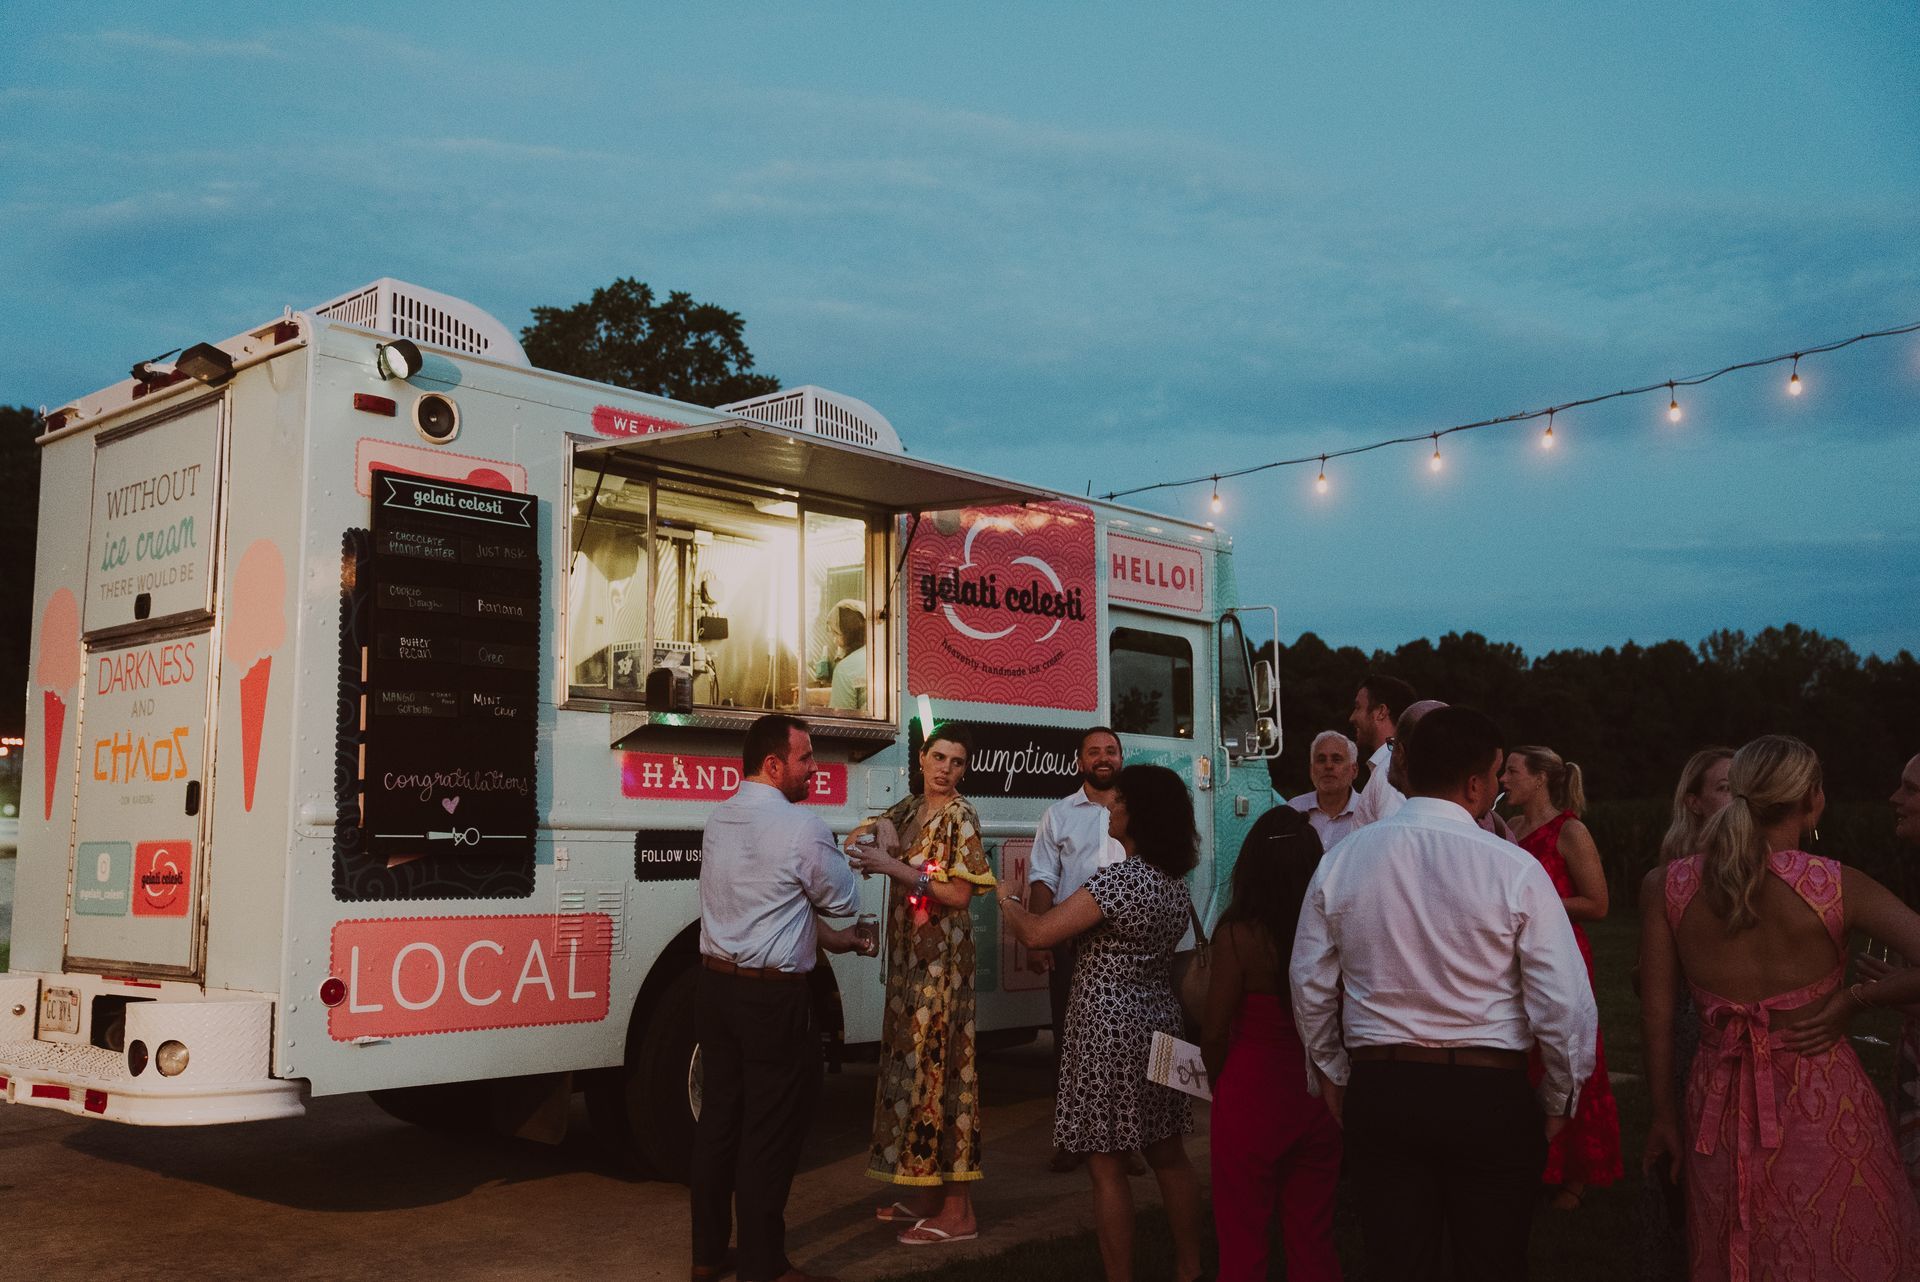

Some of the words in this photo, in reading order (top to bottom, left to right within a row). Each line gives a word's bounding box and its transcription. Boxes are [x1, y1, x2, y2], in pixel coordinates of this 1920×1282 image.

[613, 416, 639, 434] WE
[107, 464, 201, 520] WITHOUT
[414, 489, 455, 506] gelati
[458, 498, 503, 515] celesti
[101, 531, 130, 572] ice
[136, 515, 197, 561] cream
[476, 544, 500, 559] JUST
[100, 577, 133, 601] THERE
[137, 567, 177, 592] WOULD
[180, 563, 195, 582] BE
[1112, 553, 1195, 592] HELLO!
[478, 599, 523, 616] Banana
[920, 567, 999, 612] gelati
[1005, 580, 1086, 621] celesti
[98, 642, 195, 695] DARKNESS
[941, 638, 979, 671] heavenly
[981, 662, 1026, 677] handmade
[1028, 665, 1040, 675] ice
[131, 699, 155, 719] AND
[93, 726, 189, 784] CHAOS
[971, 741, 1079, 792] umptious
[641, 850, 682, 863] FOLLOW
[685, 849, 702, 862] US!
[141, 871, 161, 889] gelati
[162, 871, 183, 885] celesti
[350, 939, 596, 1013] LOCAL
